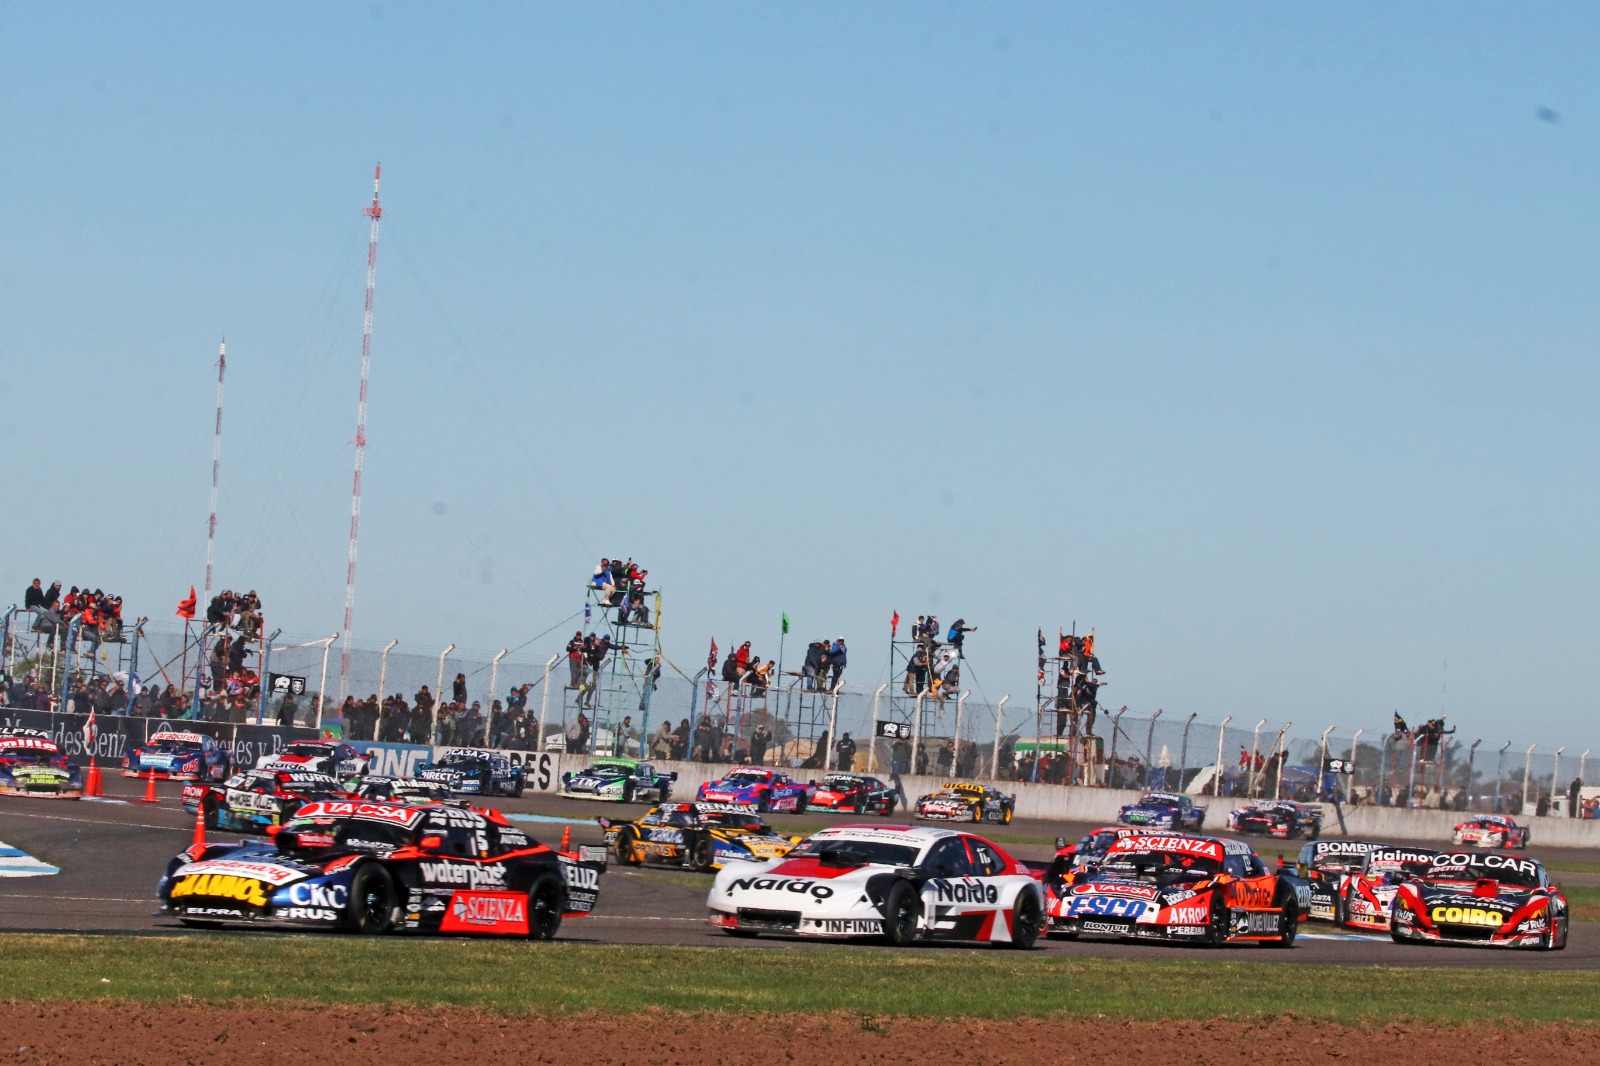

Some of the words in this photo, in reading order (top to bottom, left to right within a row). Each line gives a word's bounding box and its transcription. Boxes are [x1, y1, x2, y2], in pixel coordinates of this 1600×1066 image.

[328, 803, 408, 822] TACSA
[1135, 836, 1217, 857] SCIENZA
[1431, 853, 1537, 878] COLCAR
[288, 882, 348, 909] CKC
[1098, 883, 1153, 898] TACSA
[186, 907, 243, 918] ELPRA
[289, 907, 338, 921] RUS
[467, 896, 525, 922] SCIENZA
[1067, 895, 1148, 918] ESCO
[1168, 907, 1208, 925] AKRON
[1431, 906, 1503, 927] COIRO
